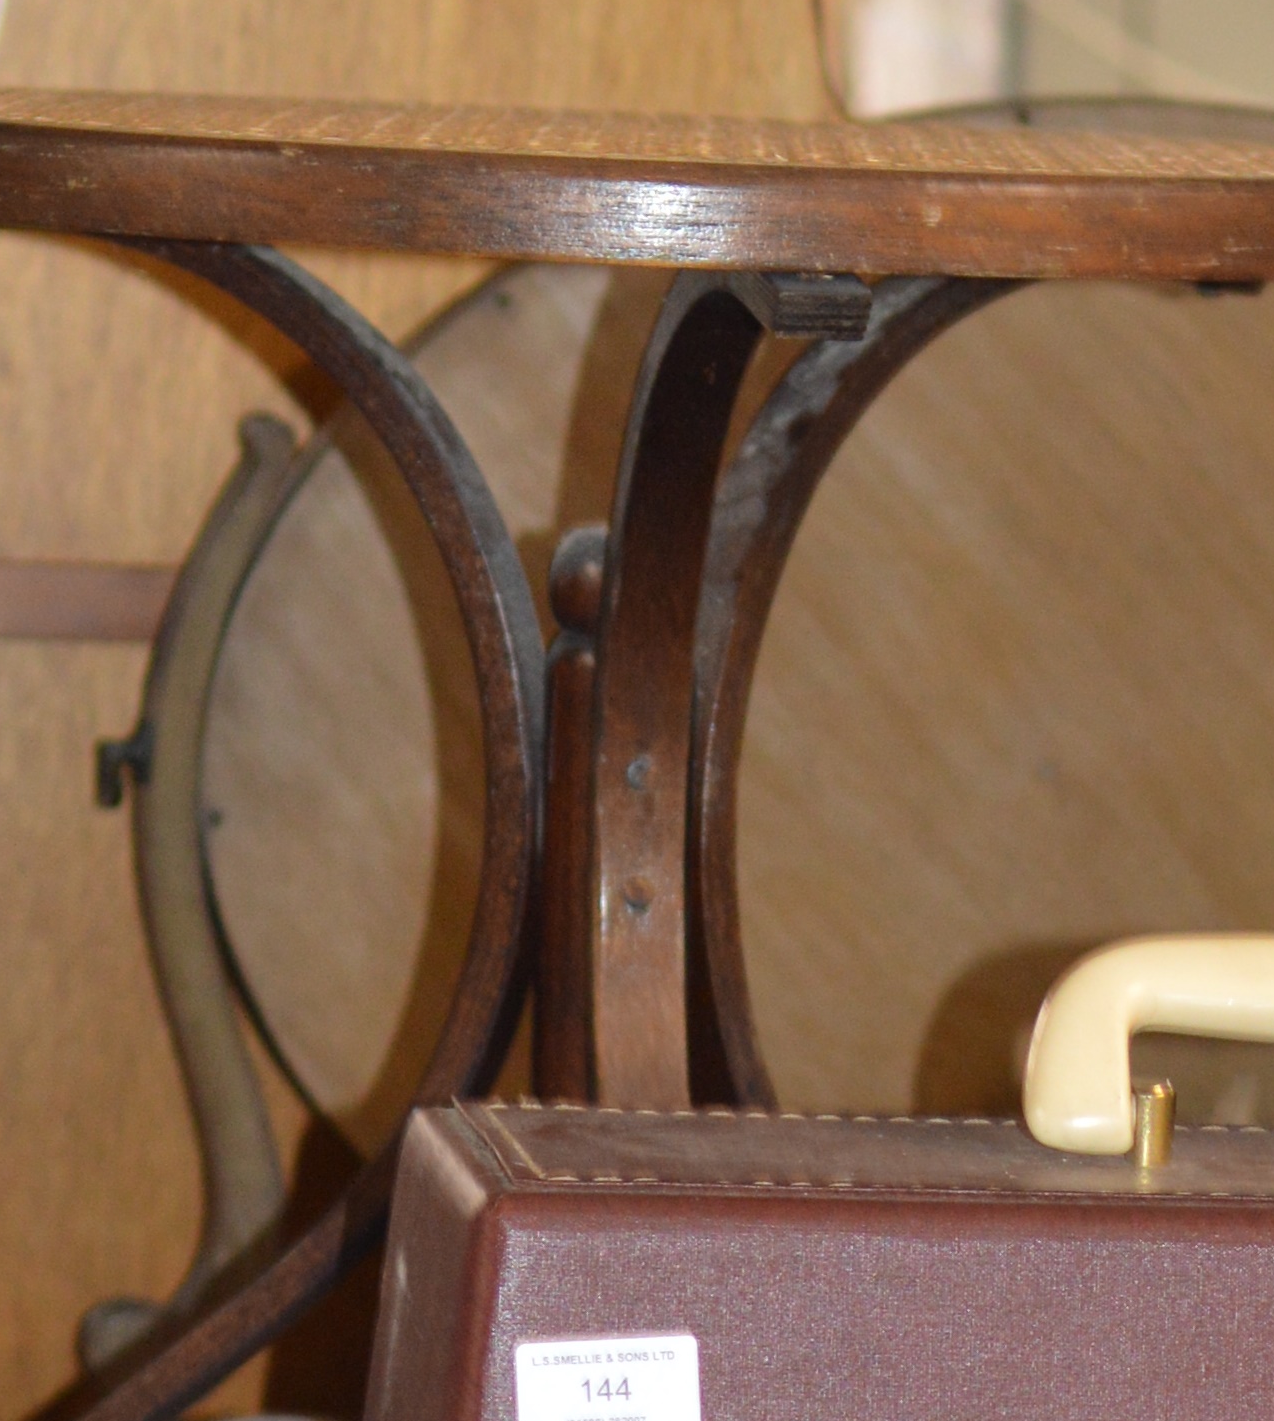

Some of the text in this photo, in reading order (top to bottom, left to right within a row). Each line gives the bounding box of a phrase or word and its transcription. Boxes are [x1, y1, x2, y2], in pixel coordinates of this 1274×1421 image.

[605, 1352, 614, 1363] &
[618, 1351, 650, 1363] SONS
[652, 1349, 676, 1361] LTD
[581, 1376, 632, 1403] 144
